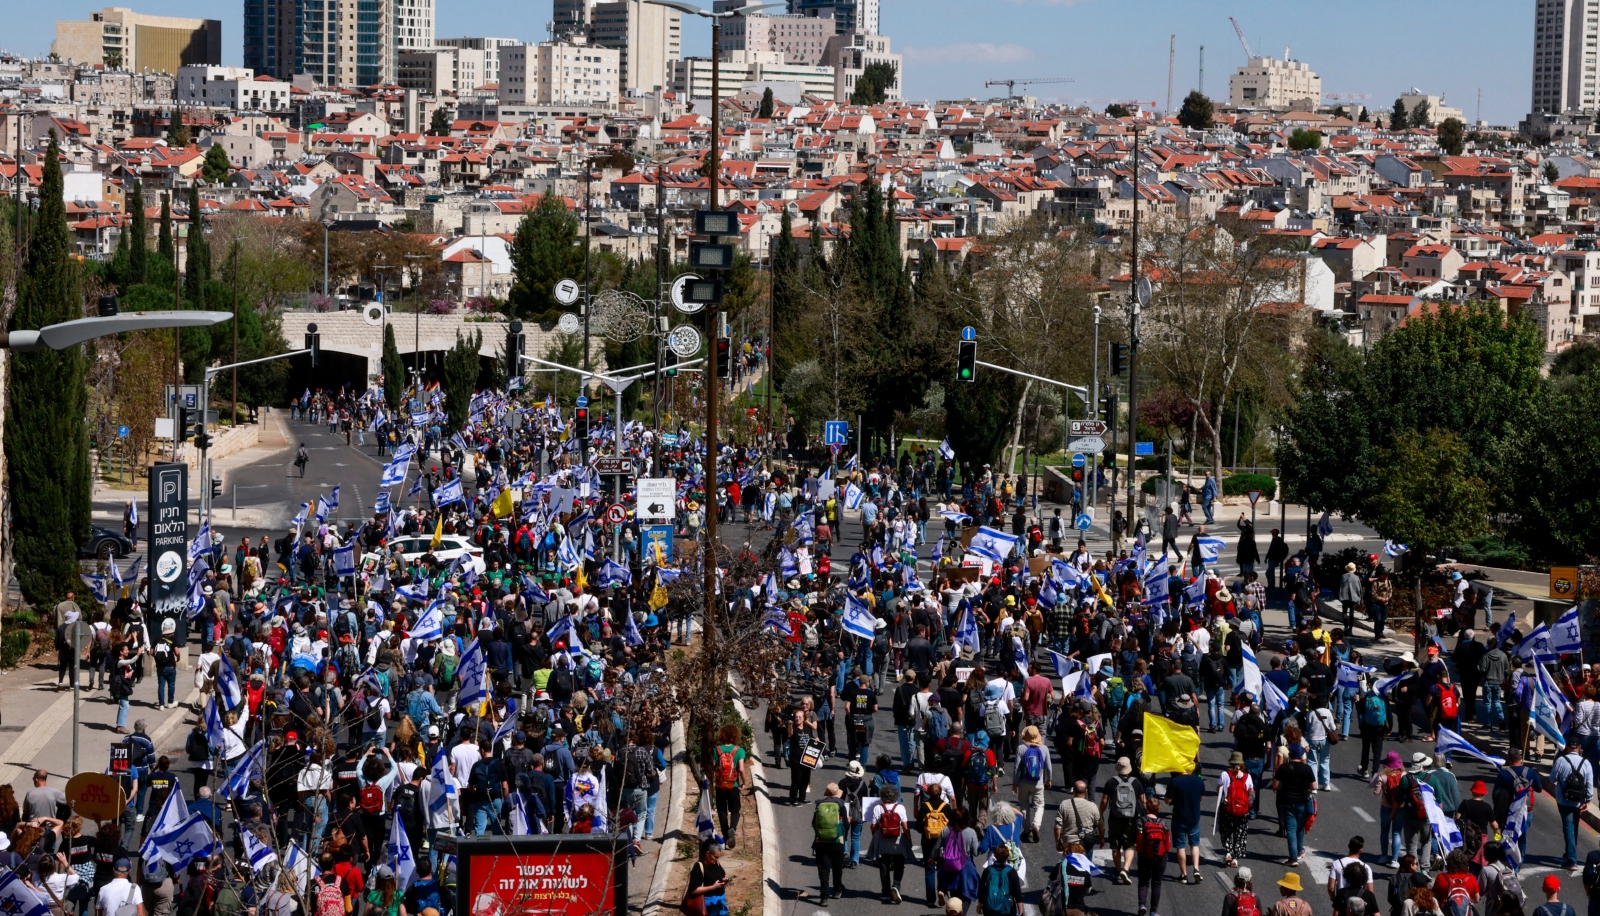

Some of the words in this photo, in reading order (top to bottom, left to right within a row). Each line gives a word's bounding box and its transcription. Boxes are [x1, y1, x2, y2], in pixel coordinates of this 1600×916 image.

[160, 506, 180, 522] חניון
[153, 520, 185, 535] הלאום
[155, 536, 184, 546] PARKING
[86, 783, 105, 794] את
[515, 865, 554, 876] אפשר
[557, 865, 572, 875] אי
[499, 878, 515, 890] זה
[518, 878, 539, 889] את
[541, 874, 588, 889] לשתות
